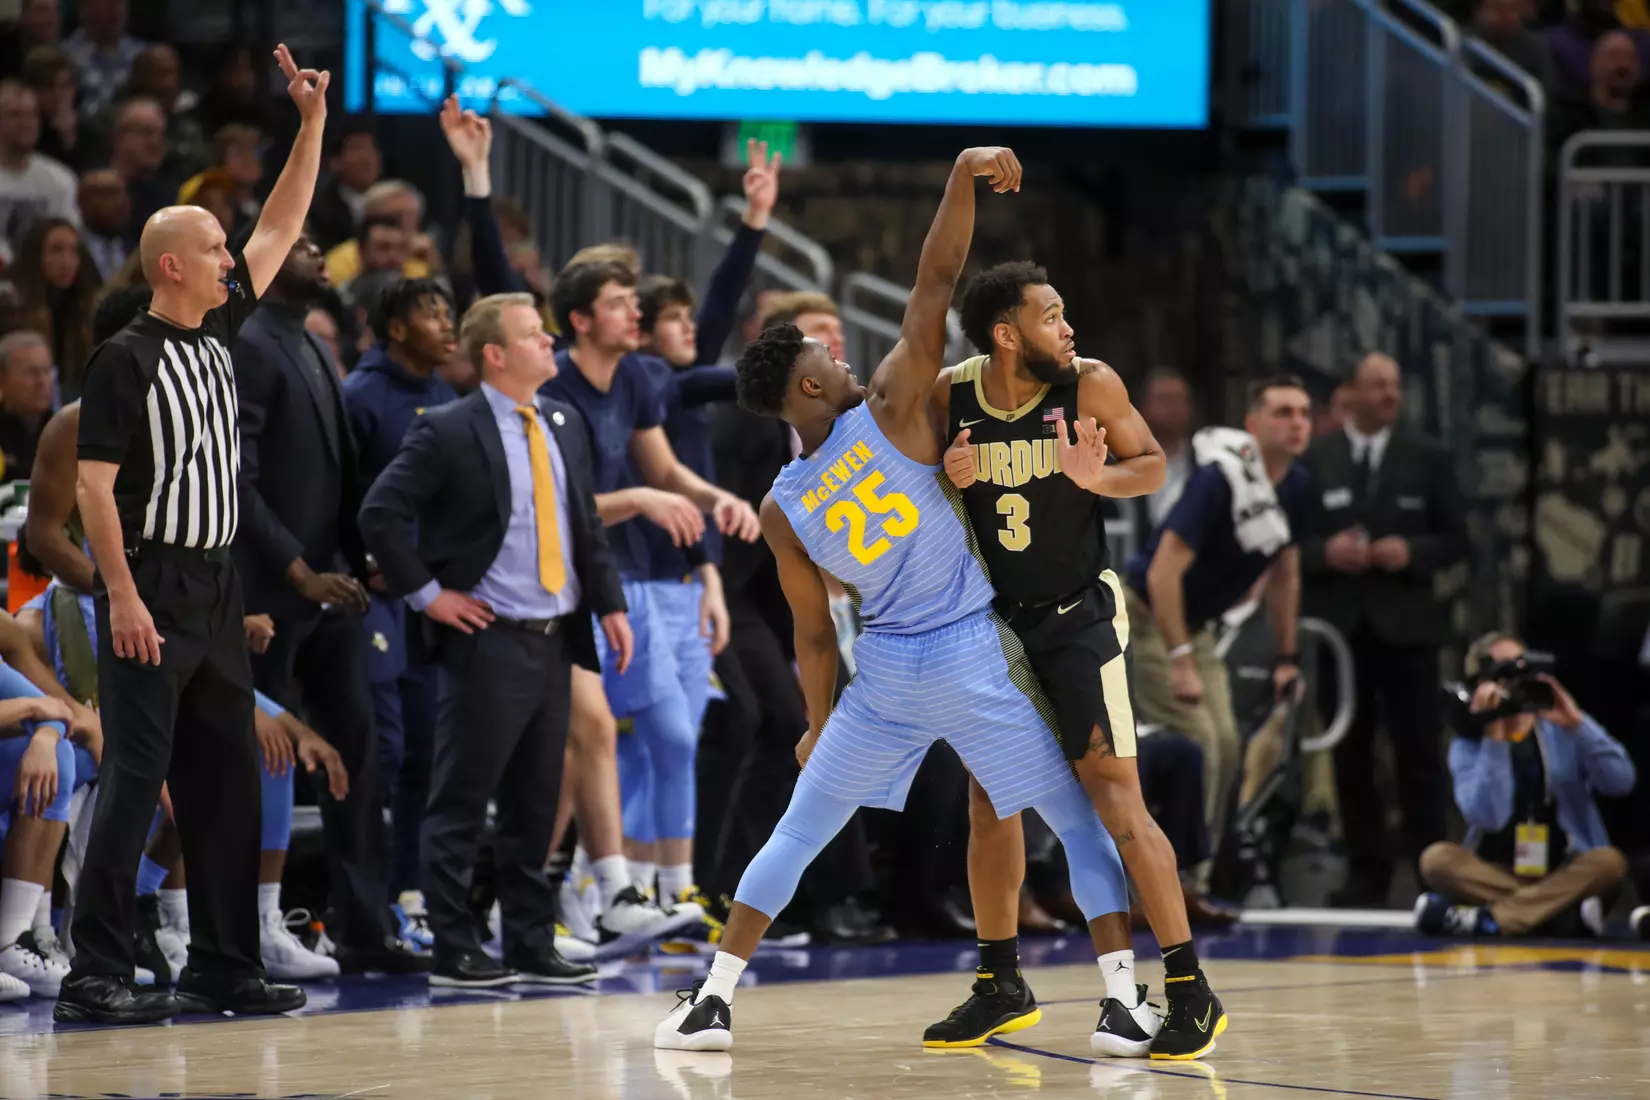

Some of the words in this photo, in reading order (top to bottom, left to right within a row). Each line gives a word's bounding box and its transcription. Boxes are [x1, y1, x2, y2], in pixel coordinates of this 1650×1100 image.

[801, 439, 874, 514] McEWEN
[967, 438, 1070, 489] URDU
[825, 469, 919, 566] 25
[996, 493, 1031, 551] 3
